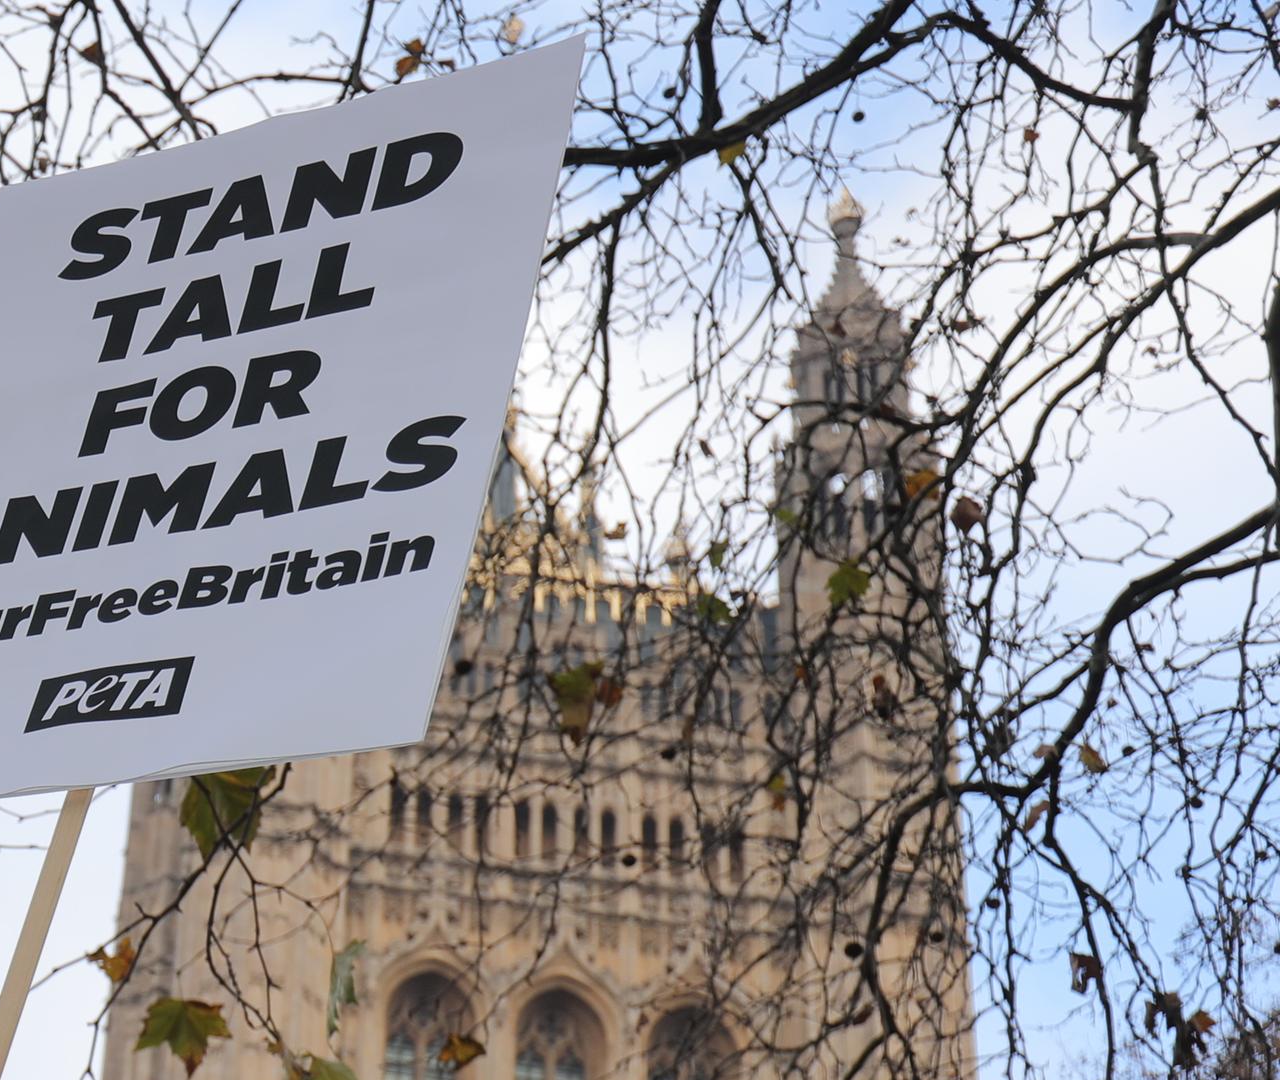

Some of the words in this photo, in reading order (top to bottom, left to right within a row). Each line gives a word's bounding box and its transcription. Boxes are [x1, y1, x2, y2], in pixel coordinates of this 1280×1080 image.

[57, 131, 464, 281] STAND
[92, 241, 376, 363] TALL
[77, 350, 322, 458] FOR
